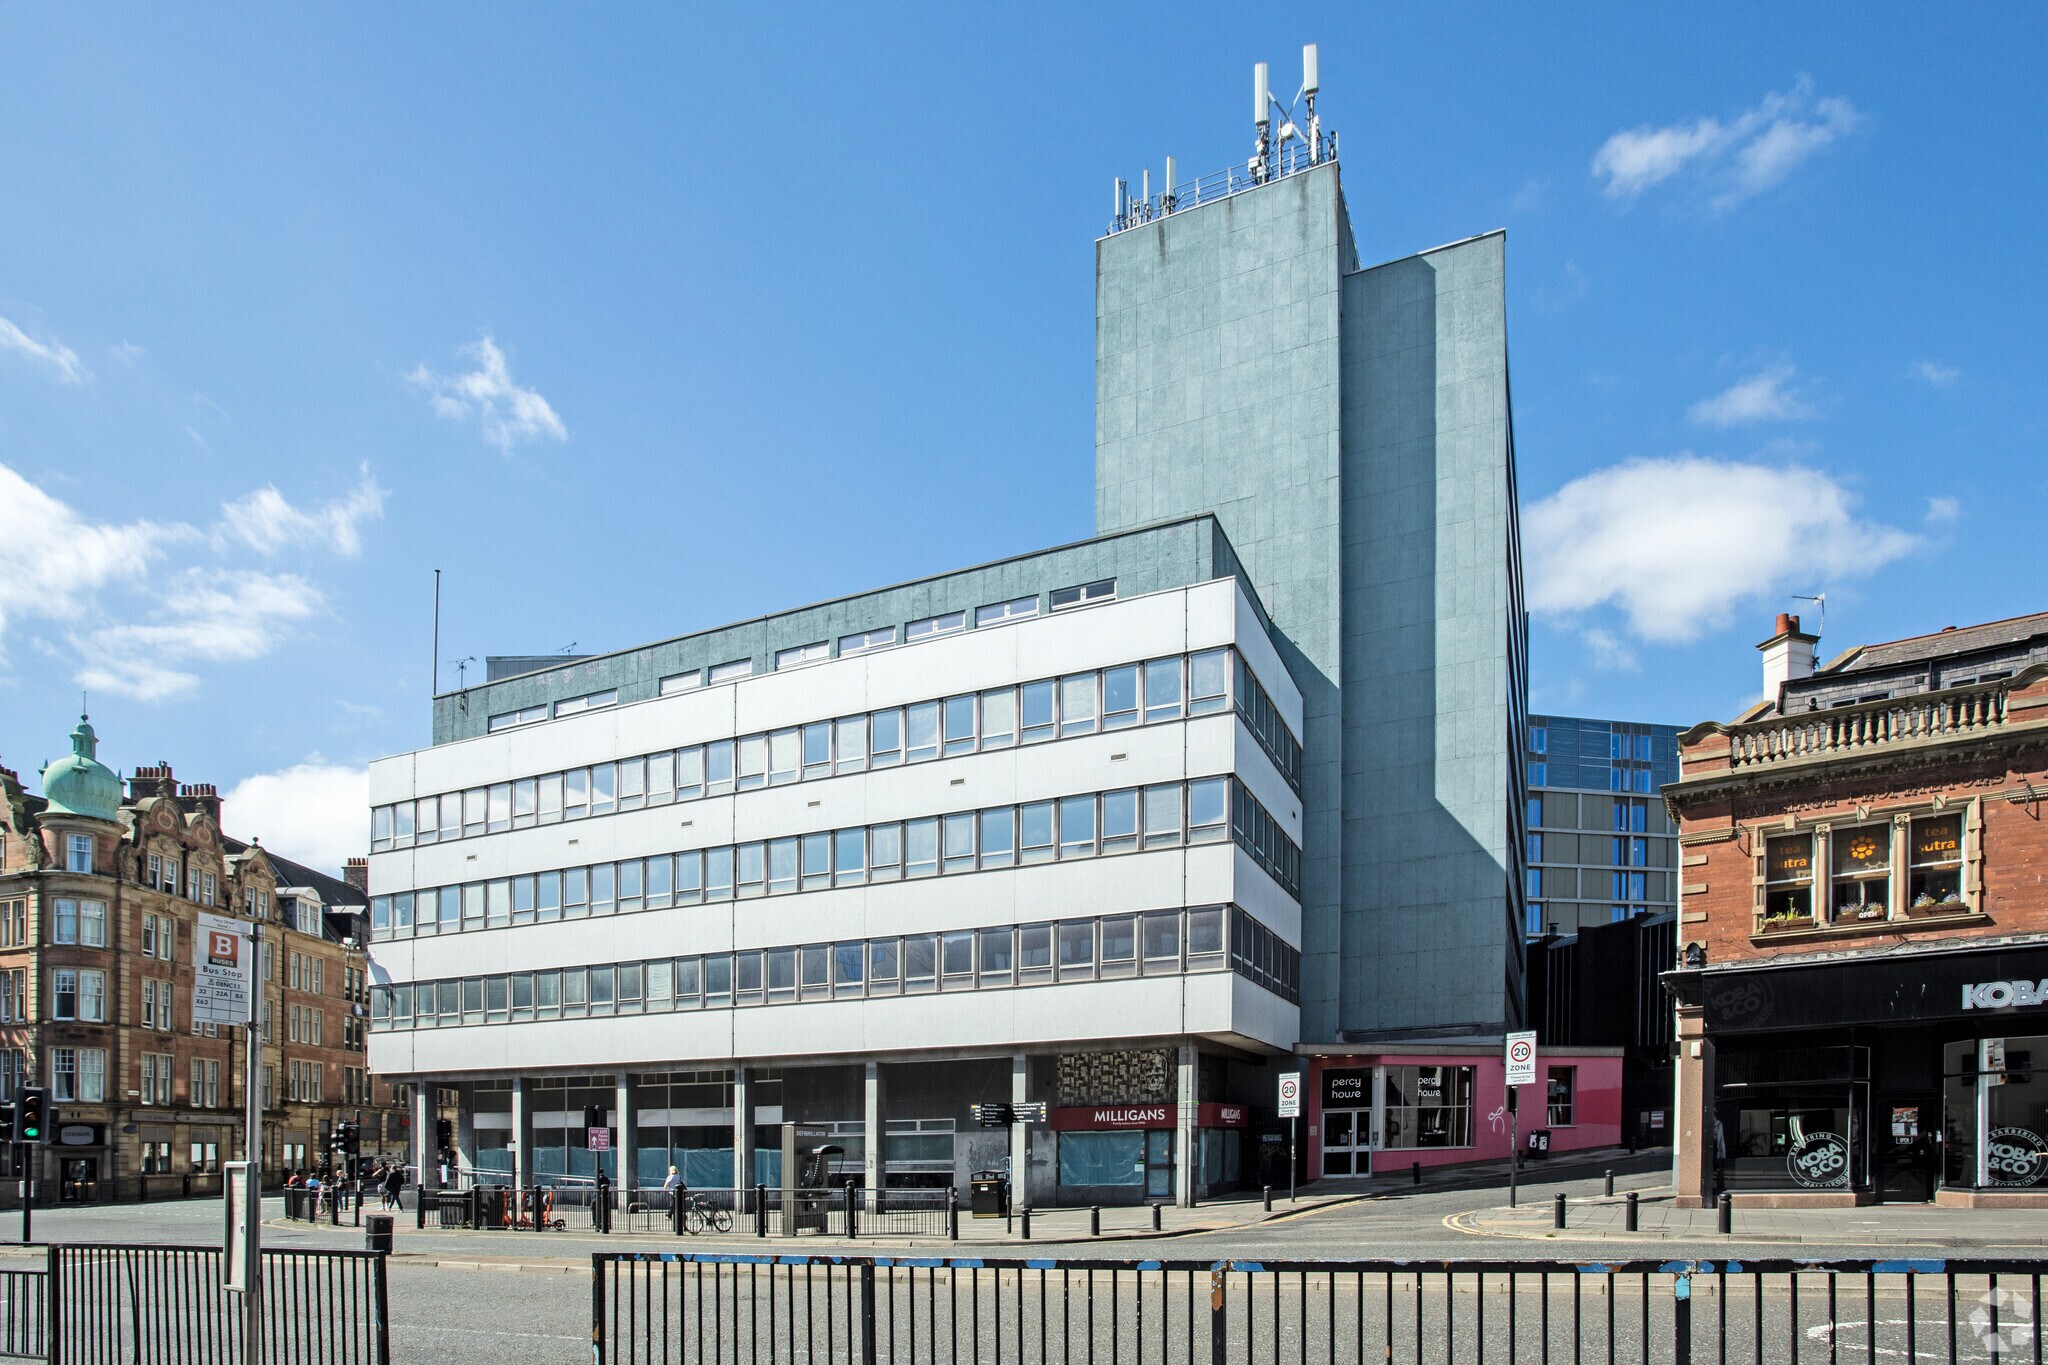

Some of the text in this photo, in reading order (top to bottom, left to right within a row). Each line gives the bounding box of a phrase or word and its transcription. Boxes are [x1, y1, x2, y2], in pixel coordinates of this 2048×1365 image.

[1925, 826, 1948, 837] tea
[1779, 844, 1801, 855] tea
[1918, 839, 1956, 852] sutra
[1858, 911, 1878, 919] OPEN
[215, 936, 232, 956] B
[212, 958, 234, 967] BUSES
[203, 966, 243, 979] Bus Stop
[1710, 982, 1762, 1010] KOBA
[1722, 996, 1760, 1020] &CO
[1514, 1047, 1528, 1056] 20
[1510, 1064, 1530, 1072] ZONE
[1332, 1078, 1362, 1088] percy
[1417, 1076, 1440, 1086] percy
[1284, 1086, 1294, 1094] 20
[1332, 1090, 1362, 1099] house
[1417, 1088, 1440, 1096] house
[1094, 1109, 1166, 1122] MILLIGANS
[1221, 1108, 1241, 1120] MILLIGANS
[1991, 1128, 2042, 1146] BARBERING
[1790, 1133, 1832, 1156] BAERING
[1797, 1143, 1842, 1170] KOBA
[1988, 1142, 2037, 1164] KOBA
[1810, 1155, 1843, 1177] &CO
[1989, 1157, 2030, 1174] &CO
[1989, 1175, 2037, 1186] GROOMING
